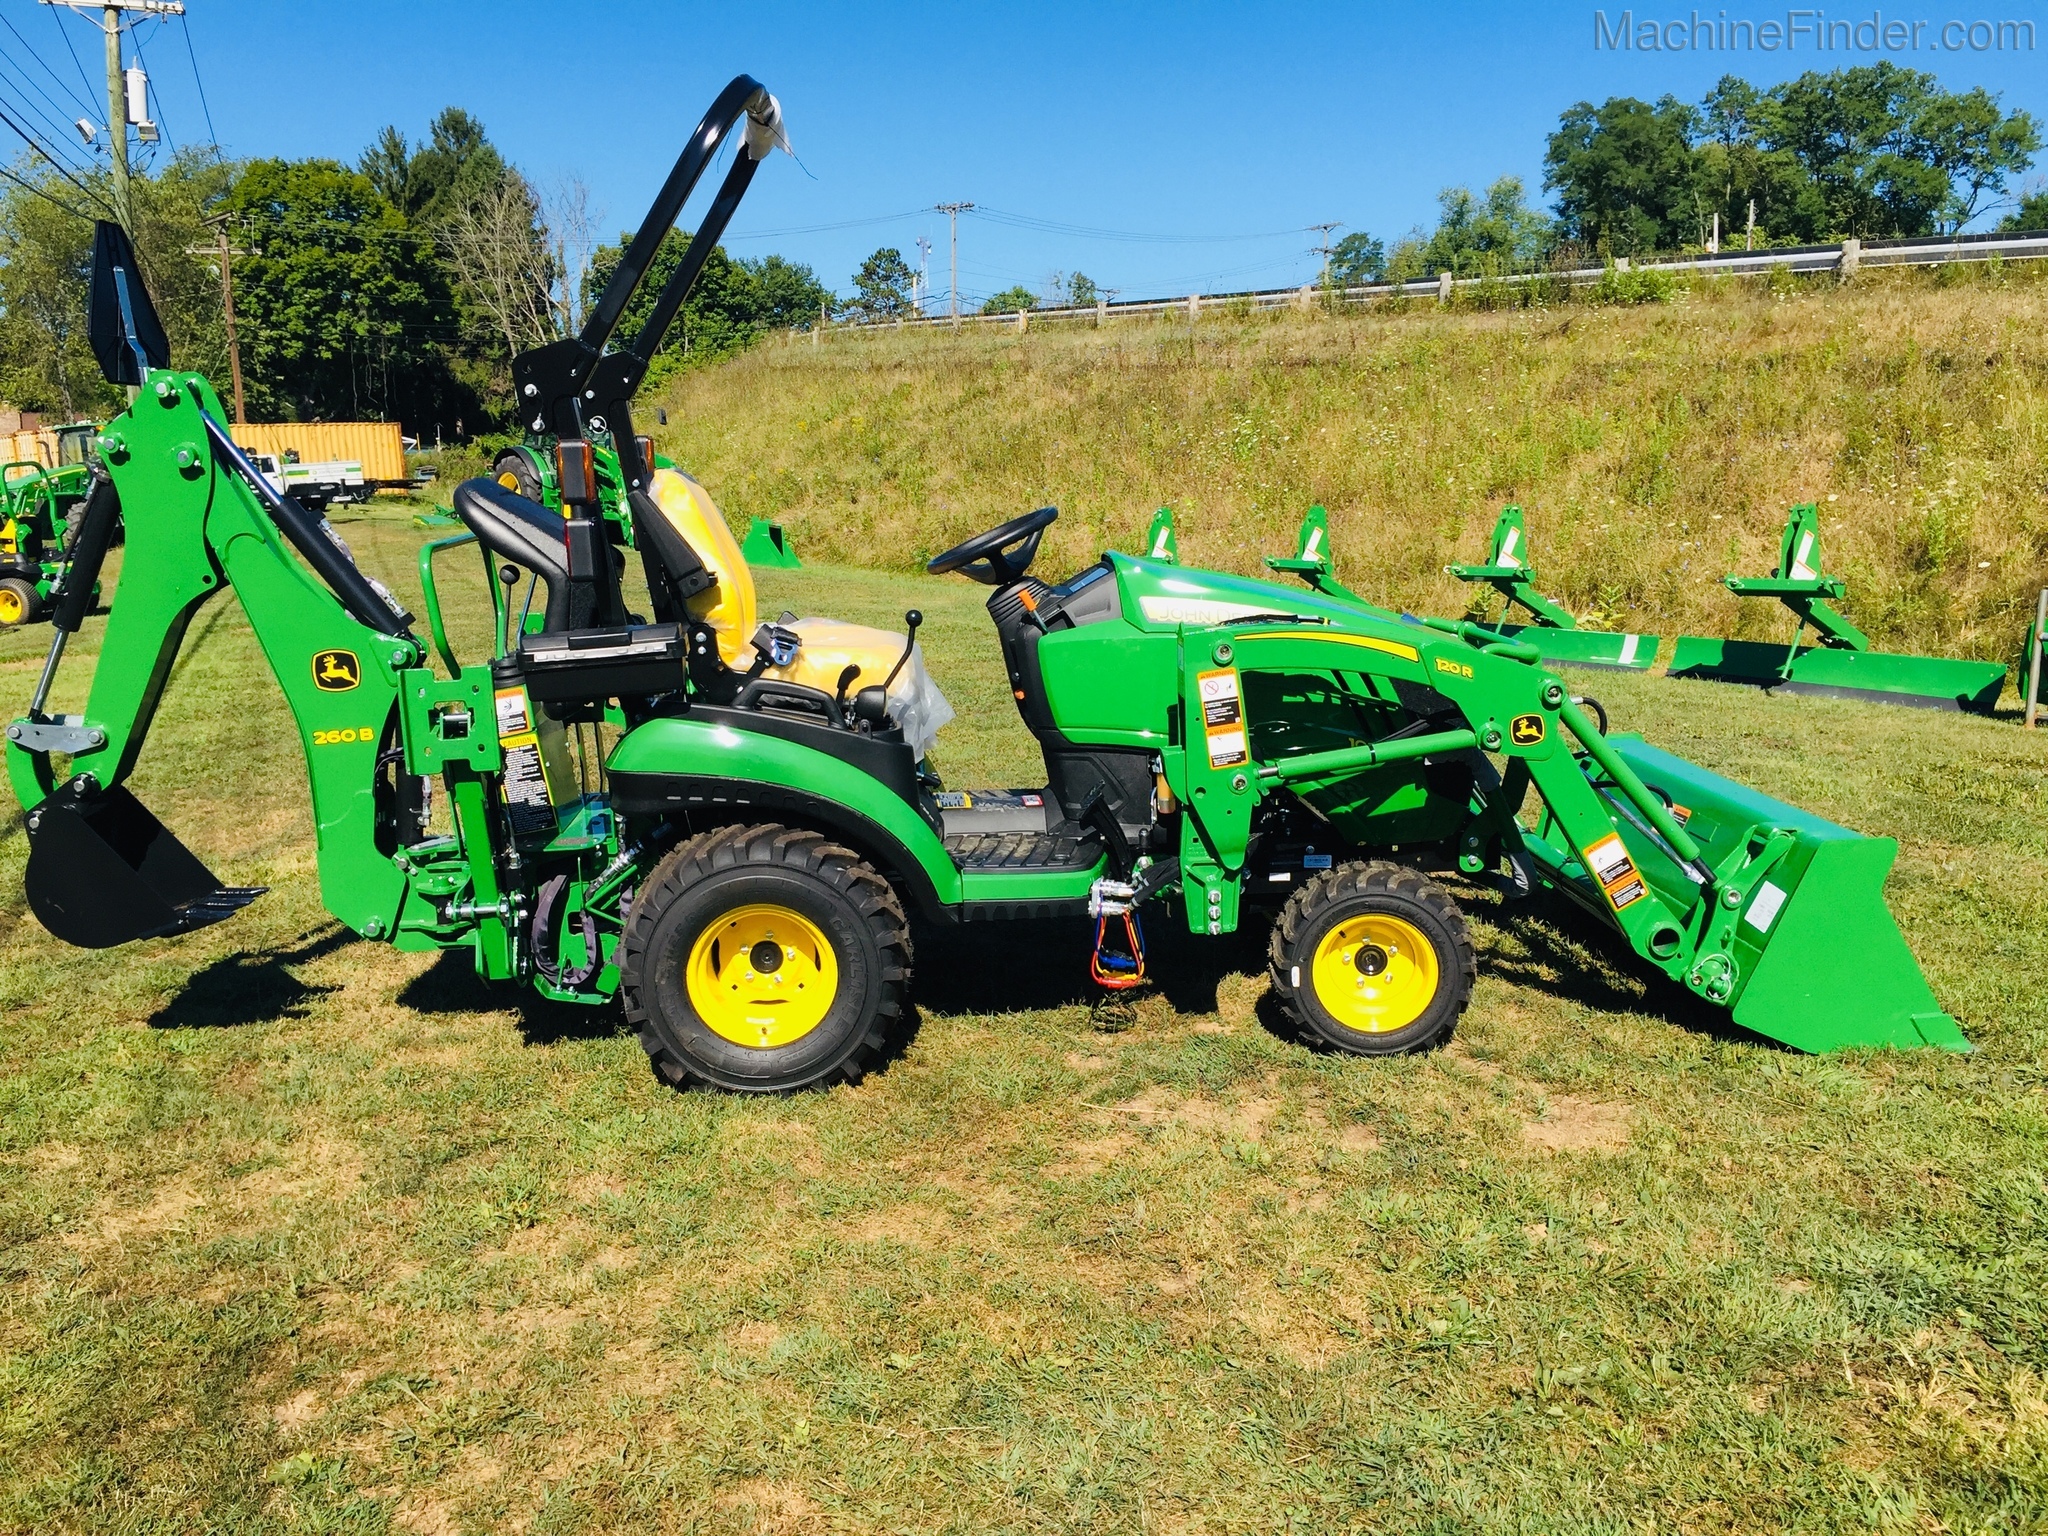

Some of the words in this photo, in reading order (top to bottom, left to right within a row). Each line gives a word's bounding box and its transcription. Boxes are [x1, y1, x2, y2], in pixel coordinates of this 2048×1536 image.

[1160, 605, 1211, 622] JOHN
[1435, 658, 1460, 674] 120
[1461, 665, 1473, 679] R
[313, 729, 356, 745] 260
[359, 727, 374, 742] B
[503, 736, 532, 747] CAUTION
